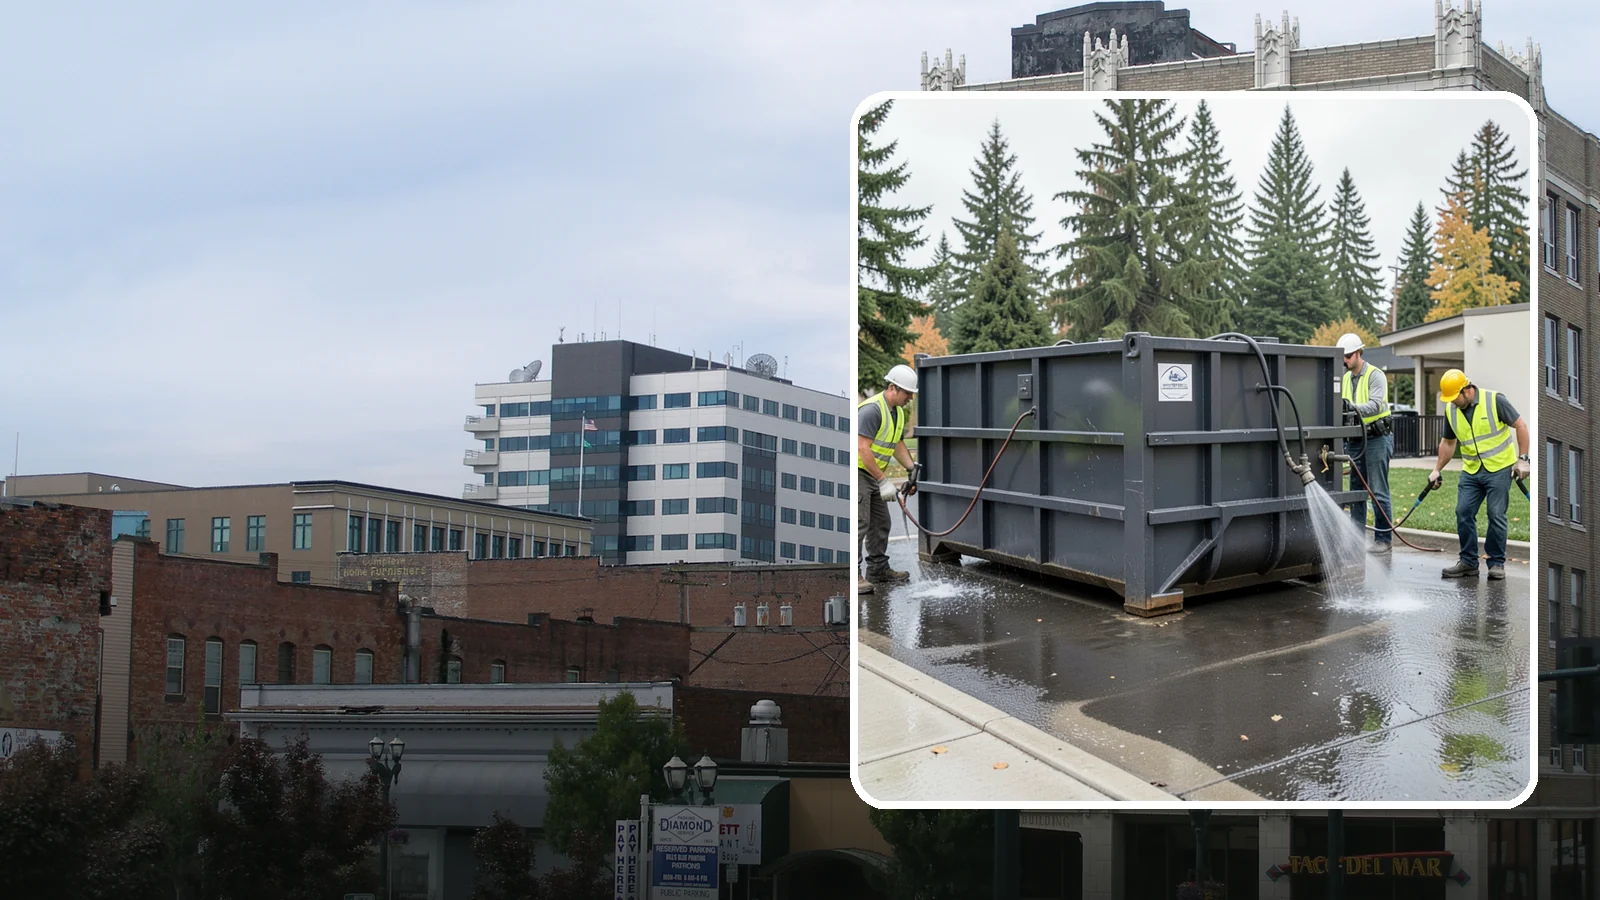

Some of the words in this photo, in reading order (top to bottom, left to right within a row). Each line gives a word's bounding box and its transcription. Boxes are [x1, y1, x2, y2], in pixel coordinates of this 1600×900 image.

[343, 568, 367, 577] Home
[370, 566, 427, 576] Furnishers
[660, 818, 713, 833] DIAMOND
[1022, 815, 1069, 828] BUILDING
[617, 825, 625, 852] PAY
[628, 824, 637, 852] PAY
[656, 845, 688, 853] RESERVED
[689, 846, 716, 854] PARKING
[721, 851, 739, 861] Soup
[671, 862, 701, 870] PATRONS
[1345, 856, 1384, 875] DEL
[1392, 858, 1442, 877] MAR
[616, 856, 625, 894] HERE
[627, 855, 636, 893] HERE
[660, 889, 682, 897] PUBLIC
[683, 889, 710, 898] PARKING
